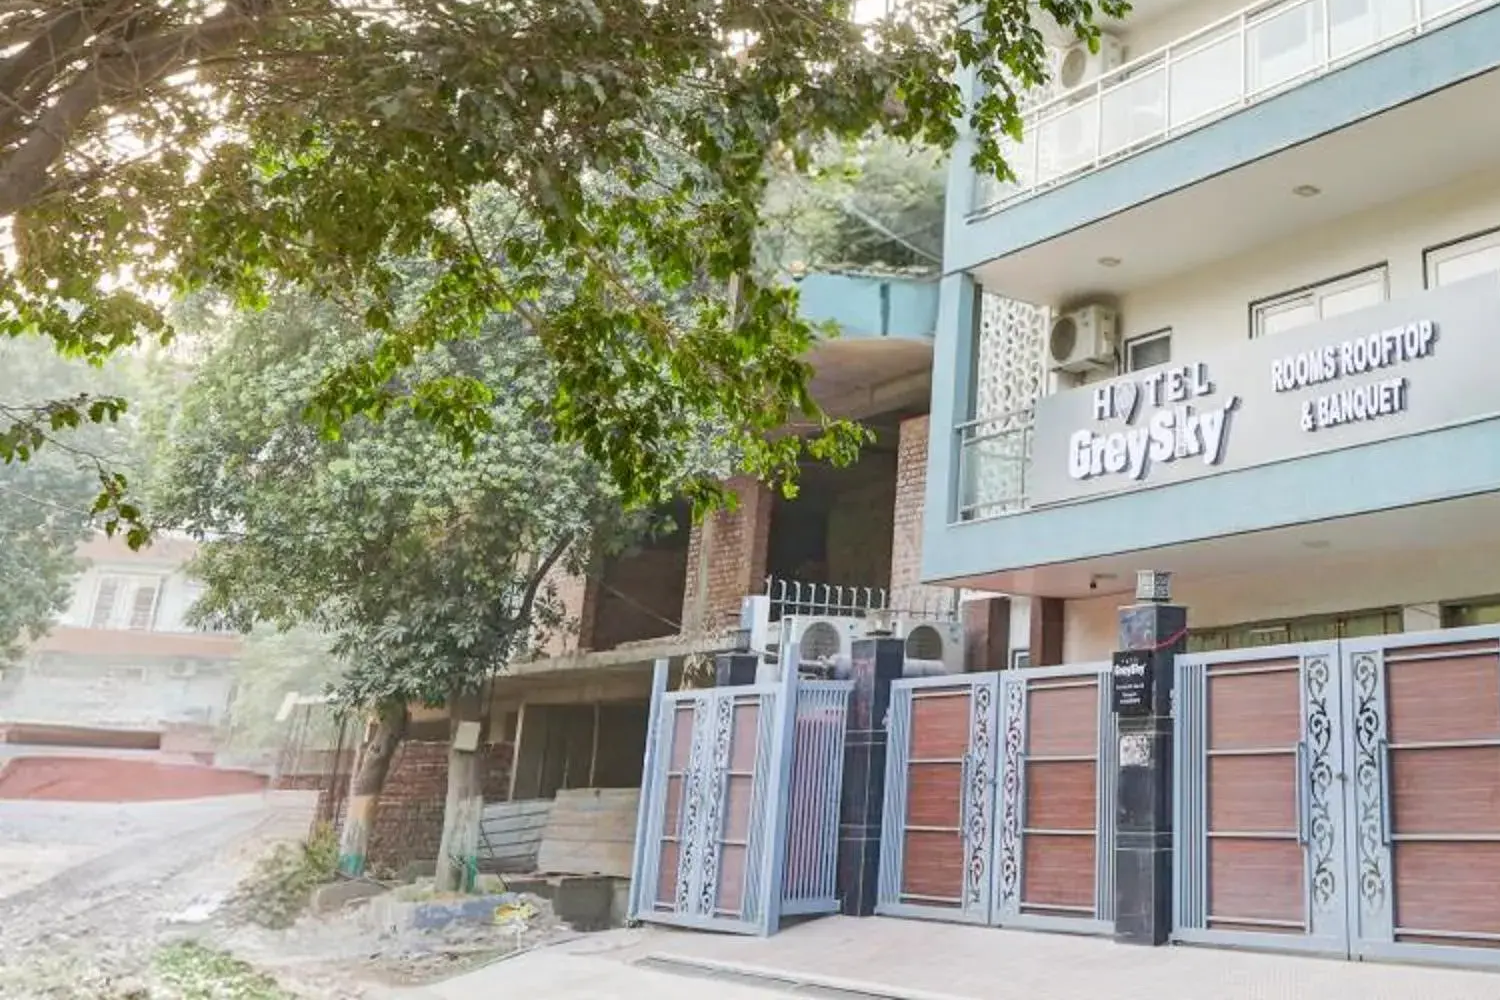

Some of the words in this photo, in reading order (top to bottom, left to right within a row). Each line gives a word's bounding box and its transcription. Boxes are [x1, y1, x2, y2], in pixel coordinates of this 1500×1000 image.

[1272, 345, 1338, 391] ROOMS
[1340, 319, 1436, 374] ROOFTOP
[1093, 362, 1214, 424] HOTEL
[1300, 401, 1317, 431] &
[1318, 377, 1407, 427] BANQUET
[1069, 397, 1240, 480] GreySky
